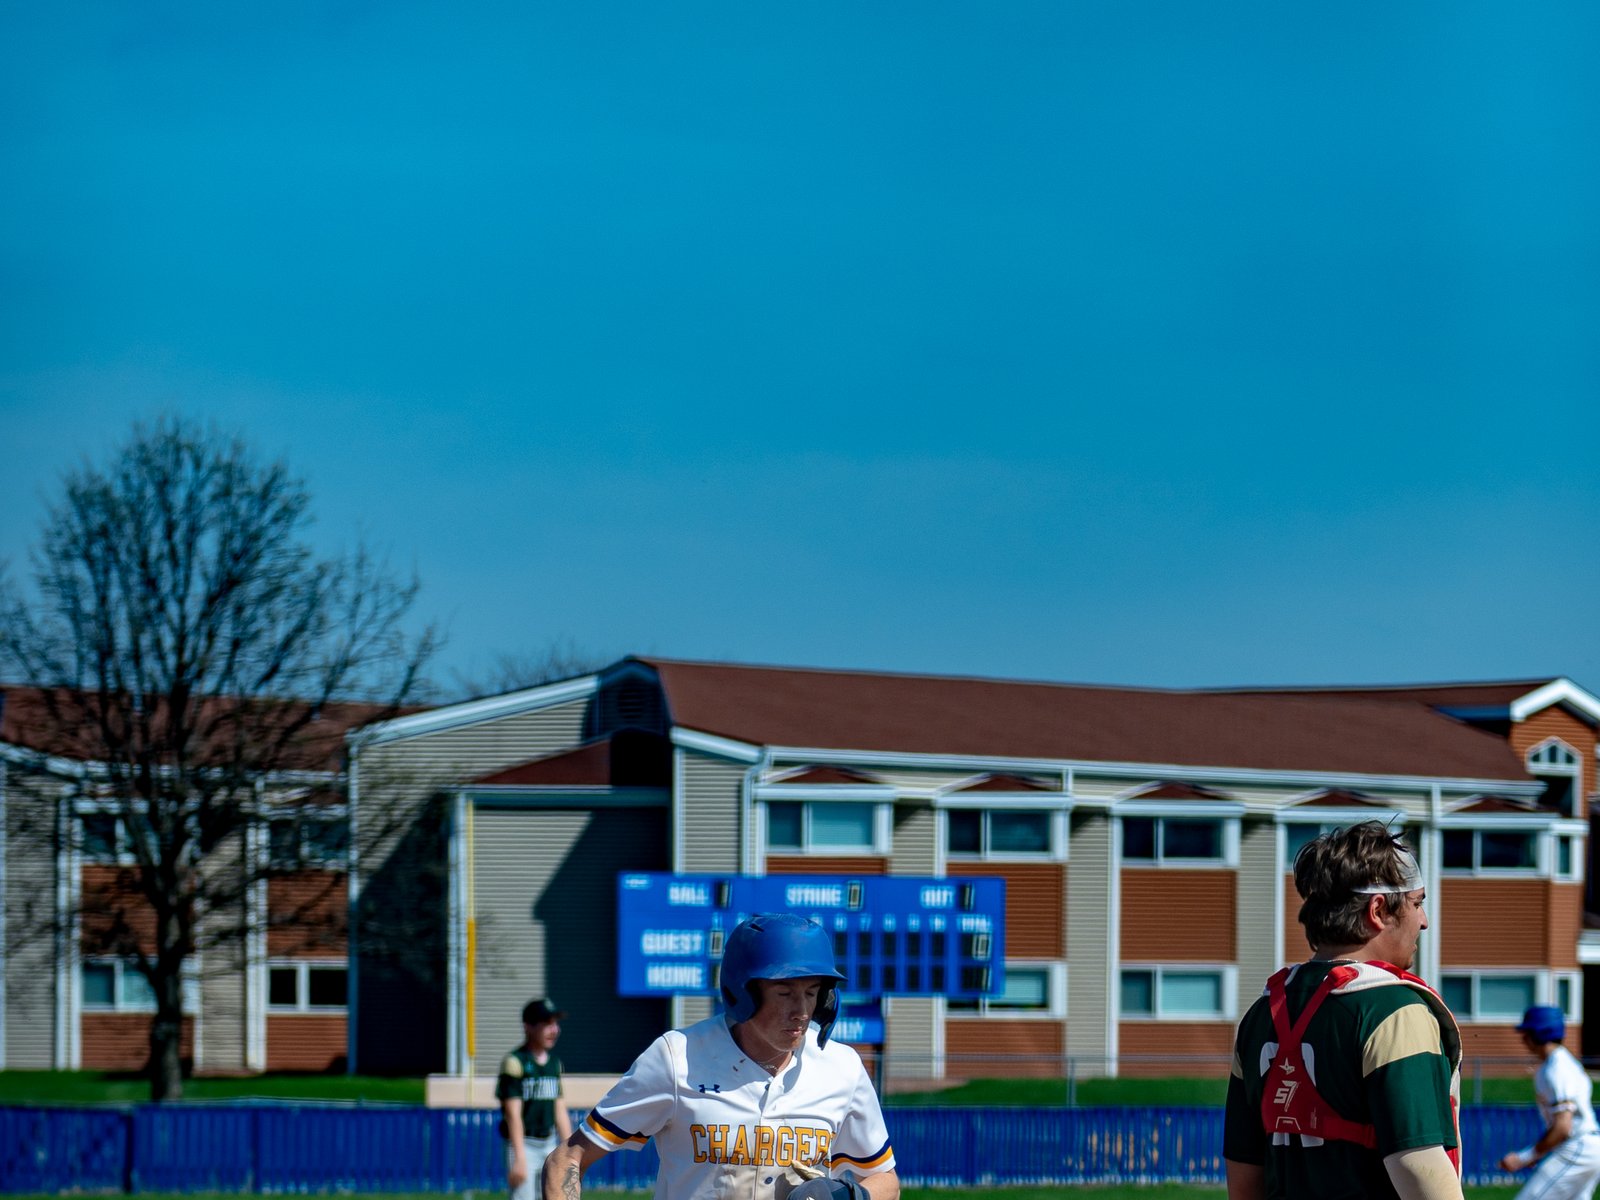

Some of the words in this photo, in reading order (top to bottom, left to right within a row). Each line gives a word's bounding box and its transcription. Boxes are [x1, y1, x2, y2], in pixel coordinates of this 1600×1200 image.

[667, 883, 708, 906] BALL
[786, 885, 842, 908] STRIKE
[921, 886, 955, 908] OUT
[642, 931, 703, 955] GUEST
[646, 964, 703, 989] HOME
[690, 1124, 836, 1167] CHARGER
